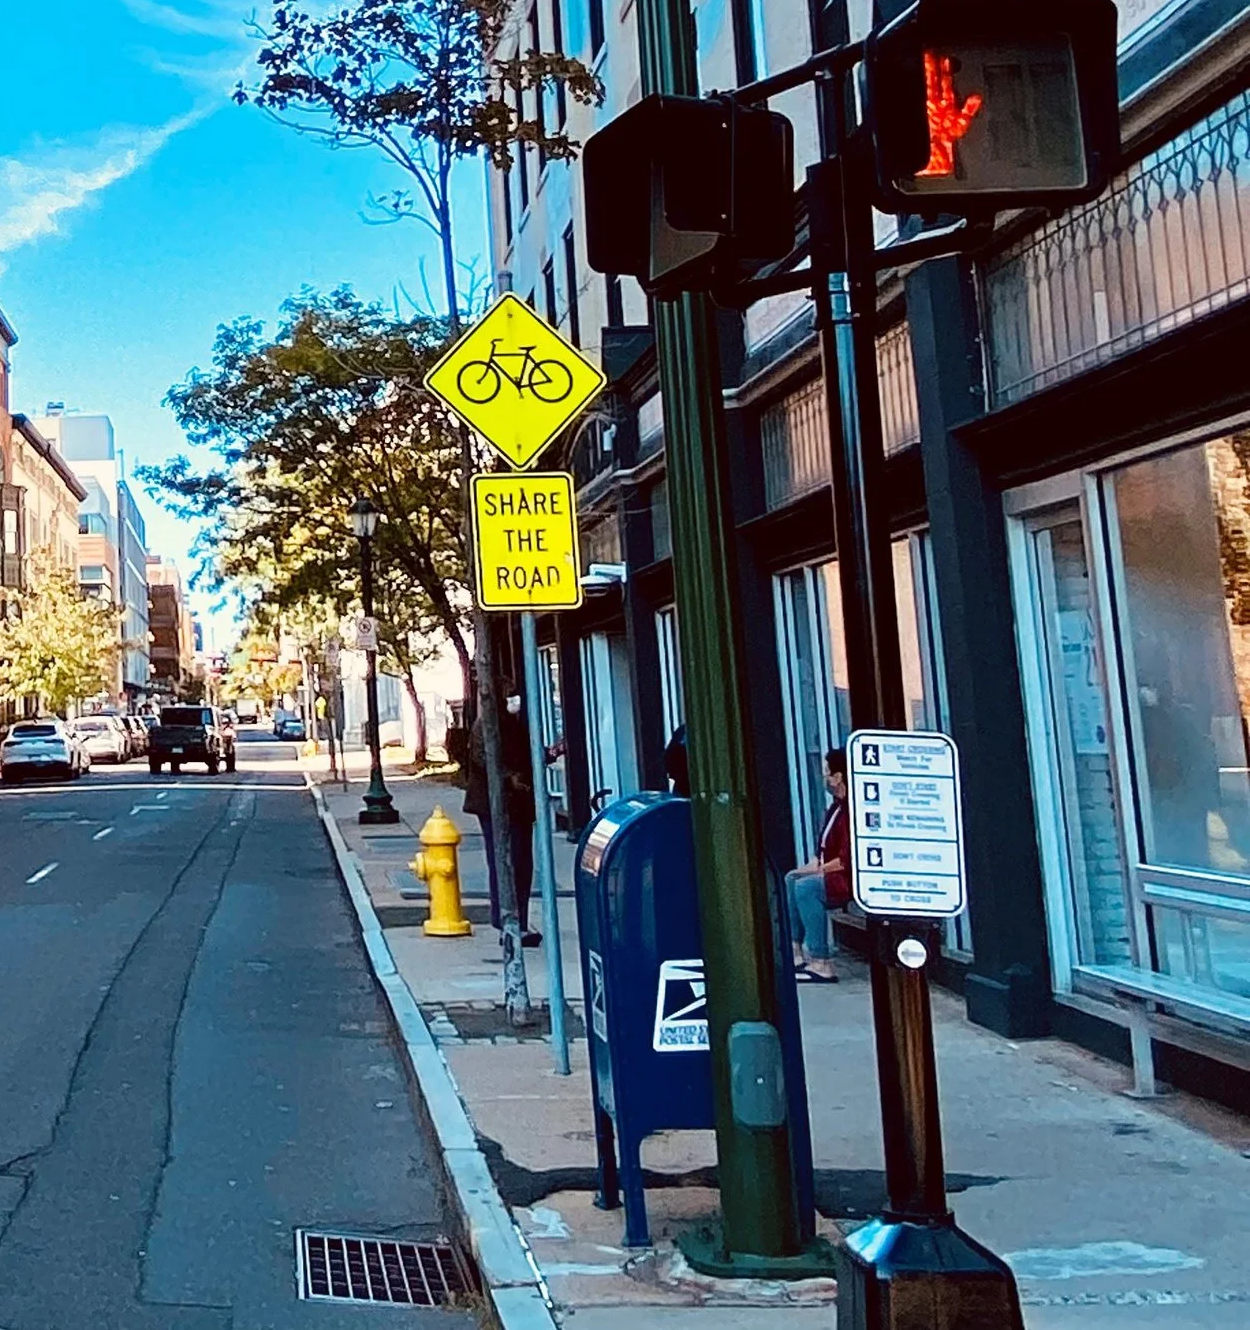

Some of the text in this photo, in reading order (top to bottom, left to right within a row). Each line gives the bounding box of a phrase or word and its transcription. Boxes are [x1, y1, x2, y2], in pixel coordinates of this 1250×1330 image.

[484, 491, 564, 517] SHARE
[503, 528, 549, 553] THE
[496, 565, 561, 591] ROAD
